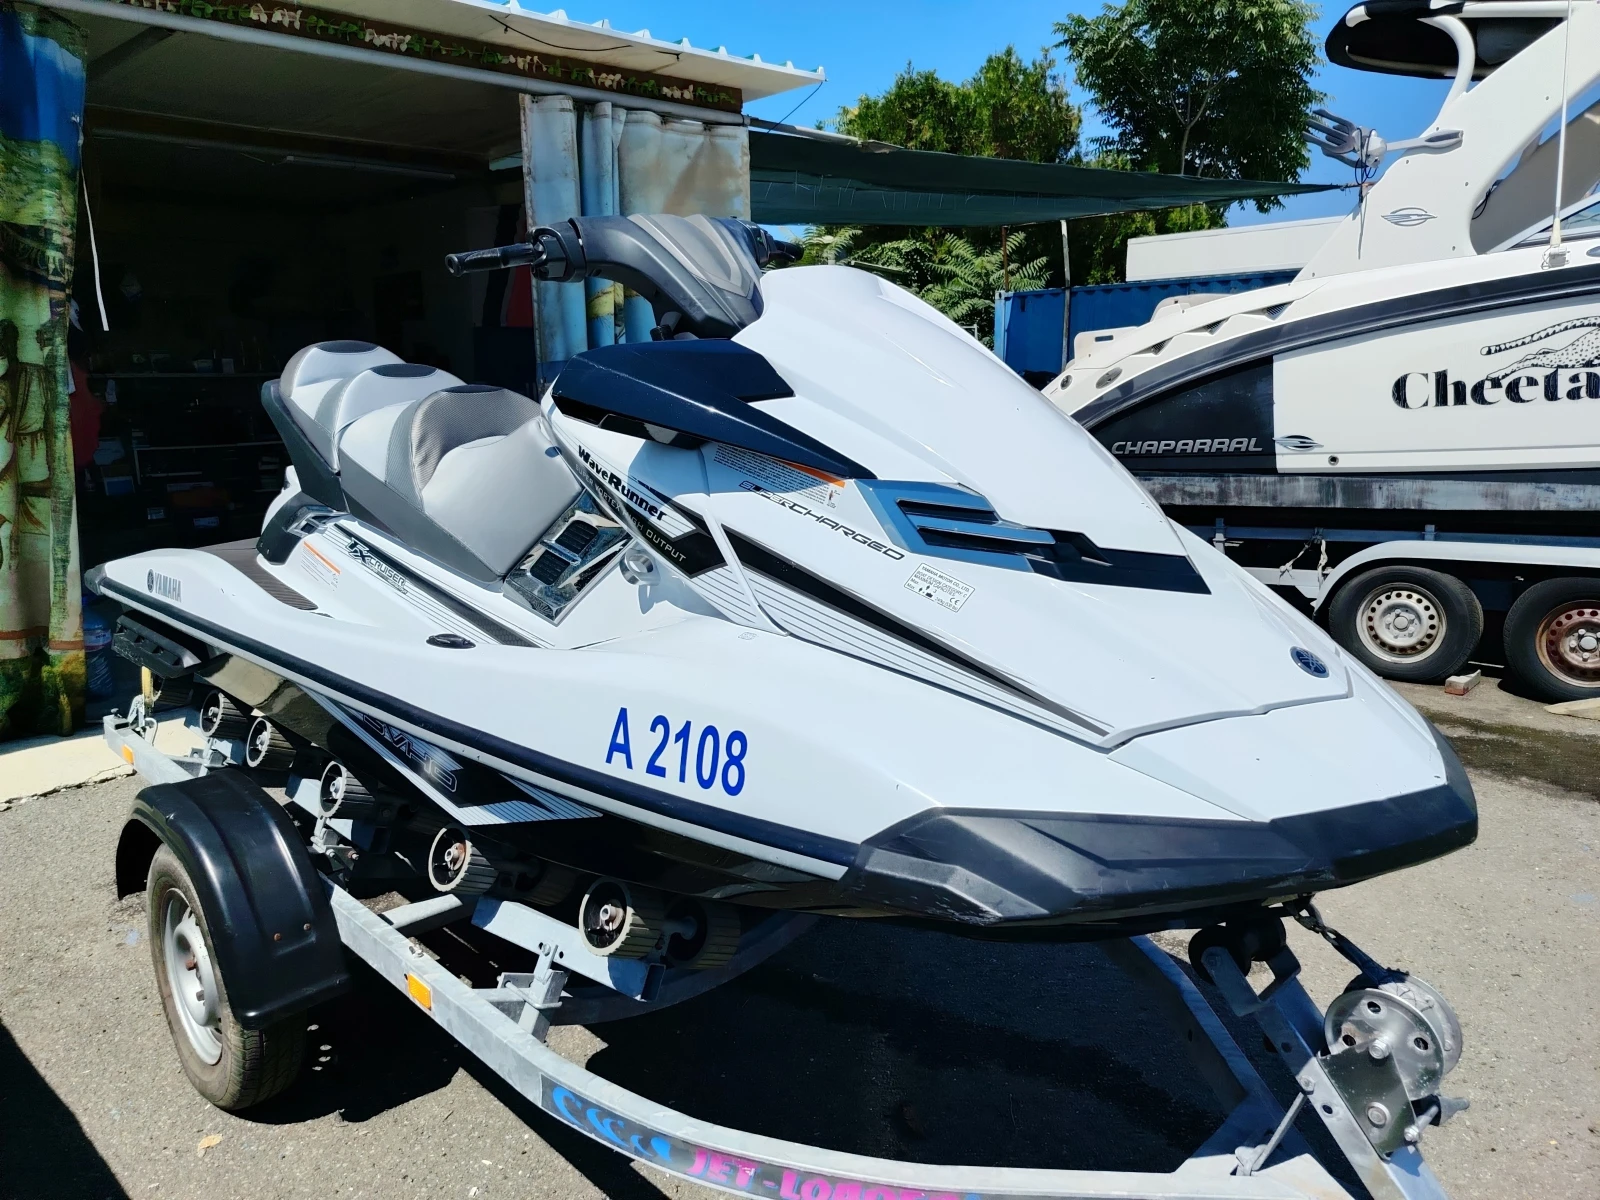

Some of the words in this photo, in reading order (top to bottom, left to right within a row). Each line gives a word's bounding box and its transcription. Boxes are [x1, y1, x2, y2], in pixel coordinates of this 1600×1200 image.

[1391, 368, 1600, 410] Cheeta
[1112, 437, 1263, 455] CHAPARRAL
[578, 444, 668, 521] WaveRunner
[575, 463, 594, 486] SUPER
[594, 482, 621, 512] VORTEX
[645, 528, 687, 562] OUTPUT
[739, 480, 905, 561] SUPERCHARGED
[154, 571, 182, 603] YAMAHA
[345, 537, 373, 565] FX
[369, 557, 406, 587] CRUISER
[921, 565, 939, 577] YAMAHA
[938, 573, 953, 584] MOTOR
[605, 706, 633, 770] A
[645, 714, 748, 797] 2108
[685, 1148, 961, 1200] JET-LOA
